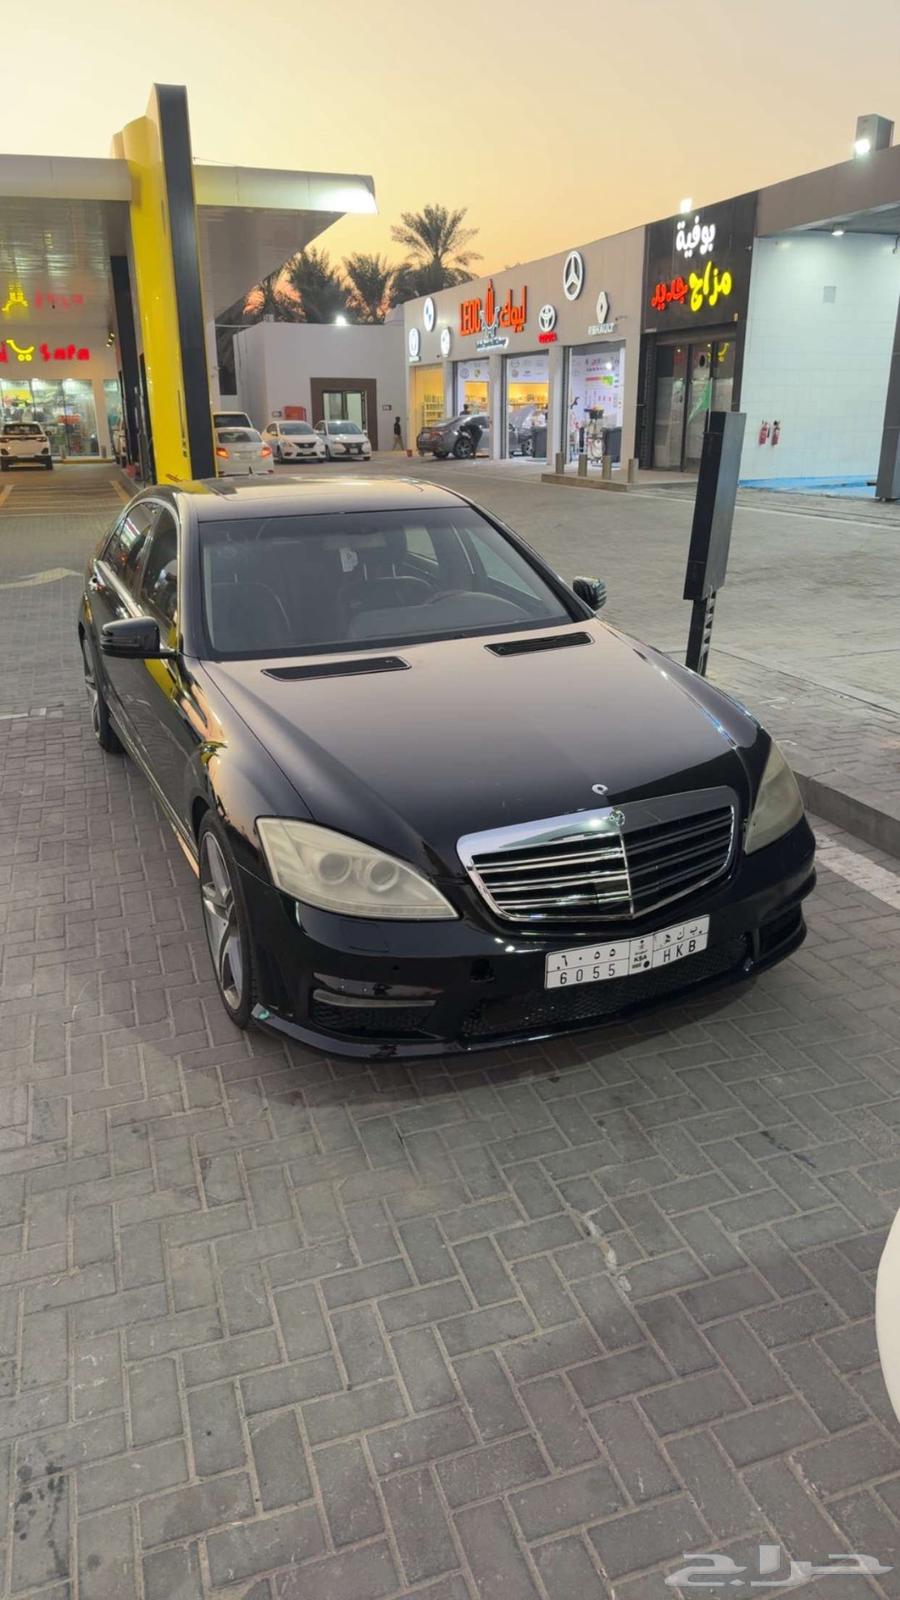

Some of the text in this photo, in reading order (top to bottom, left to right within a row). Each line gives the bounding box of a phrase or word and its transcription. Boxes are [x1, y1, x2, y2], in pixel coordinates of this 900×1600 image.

[676, 215, 715, 258] بوفية
[651, 260, 731, 311] مزاج جديد
[38, 343, 90, 363] Safa
[664, 940, 696, 962] HKB
[560, 963, 615, 984] 6055
